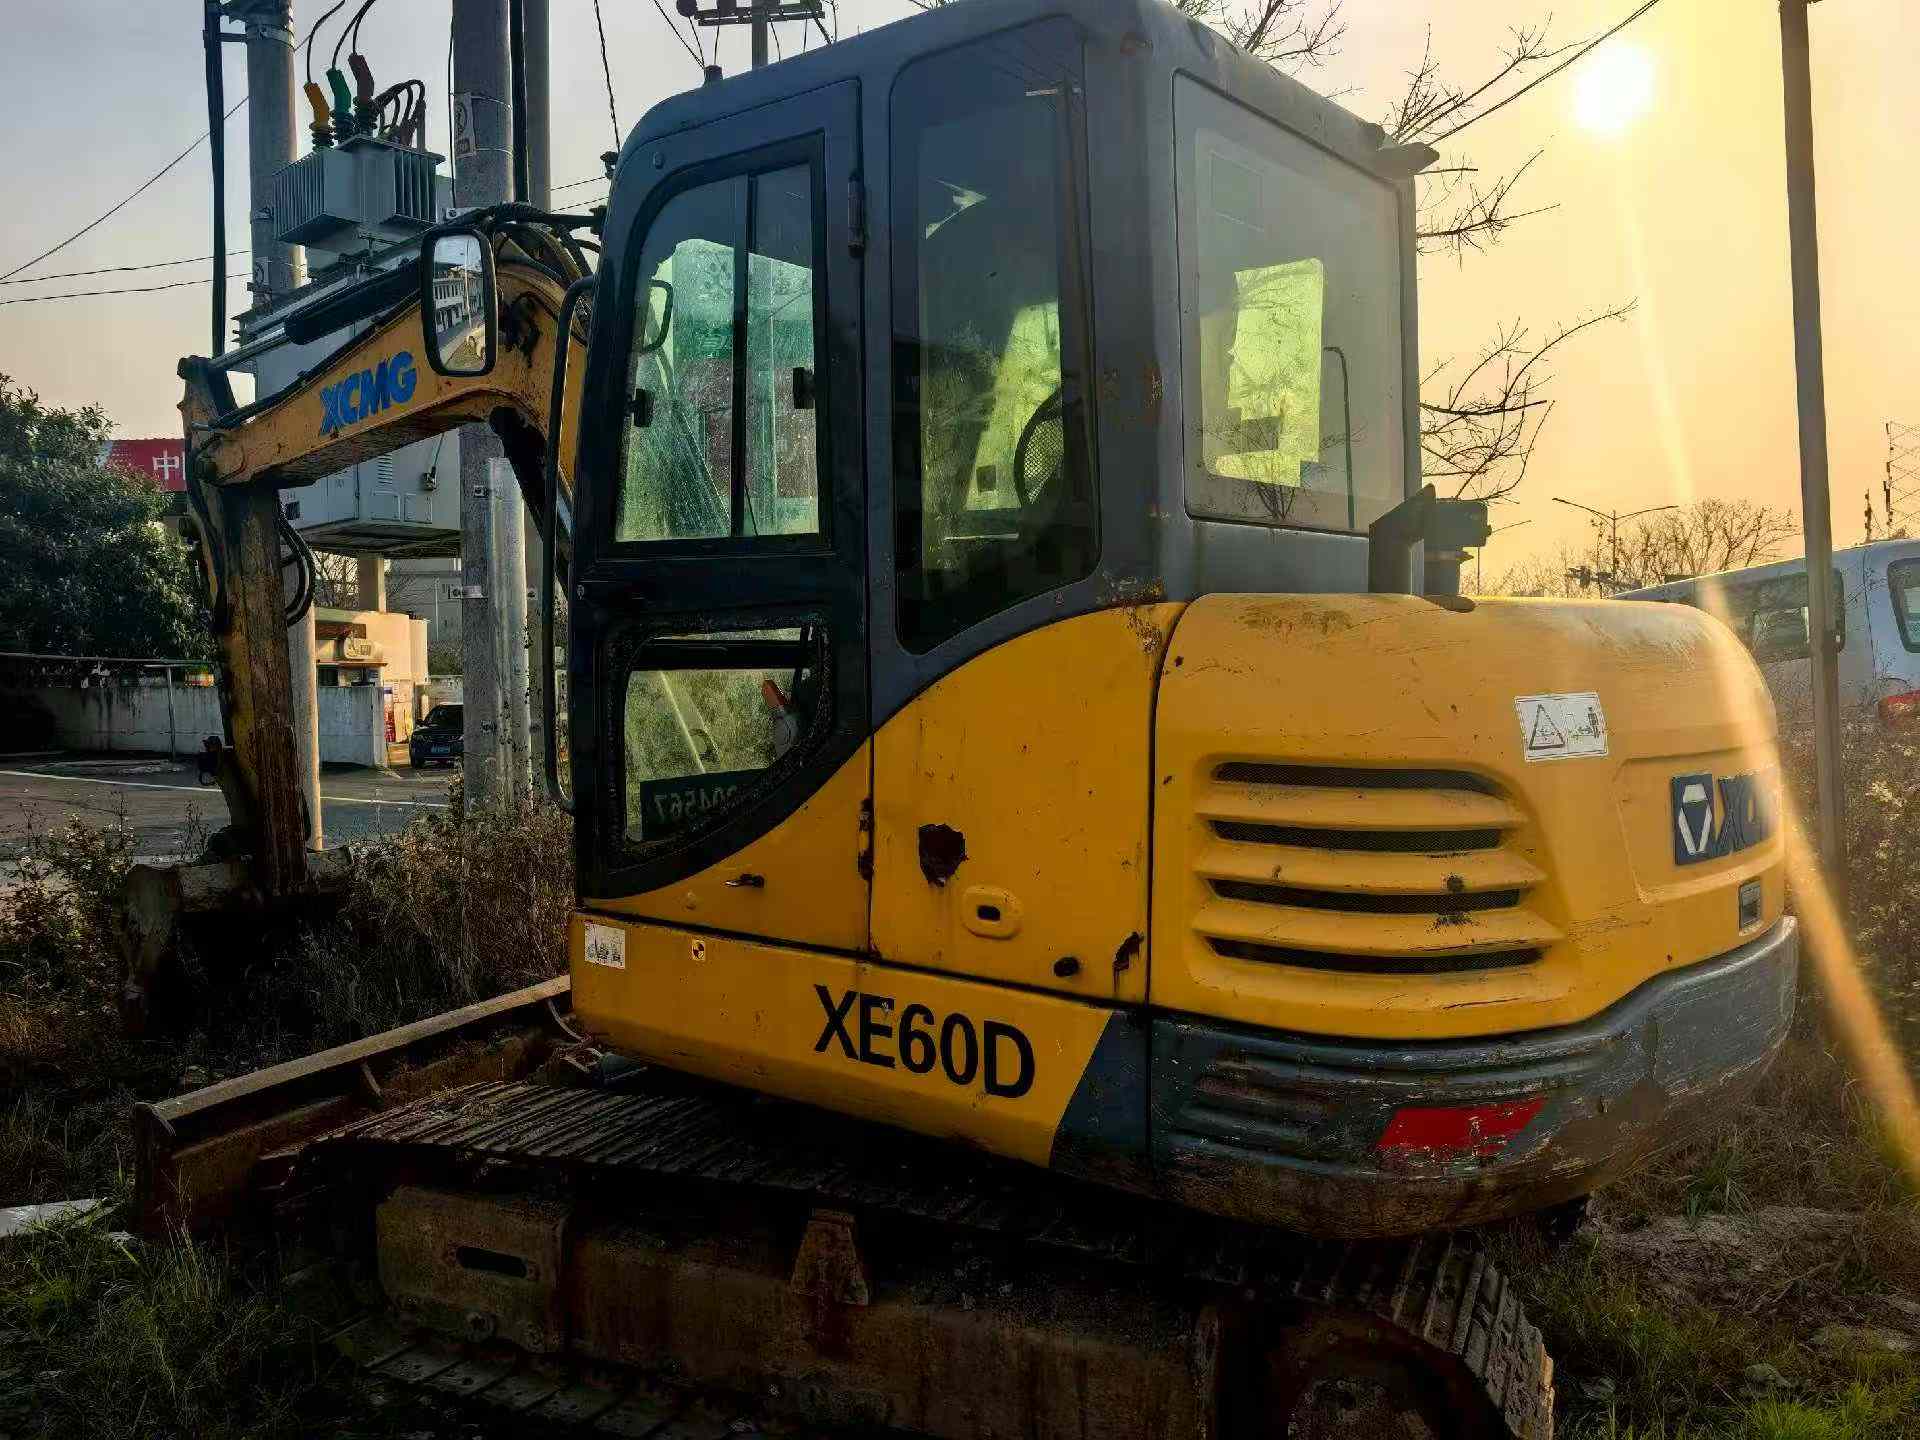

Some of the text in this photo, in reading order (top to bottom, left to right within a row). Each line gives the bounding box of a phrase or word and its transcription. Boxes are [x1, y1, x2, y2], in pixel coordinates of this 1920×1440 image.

[320, 351, 417, 436] XCMG
[152, 448, 186, 481] 中
[814, 984, 1035, 1099] XE60D
